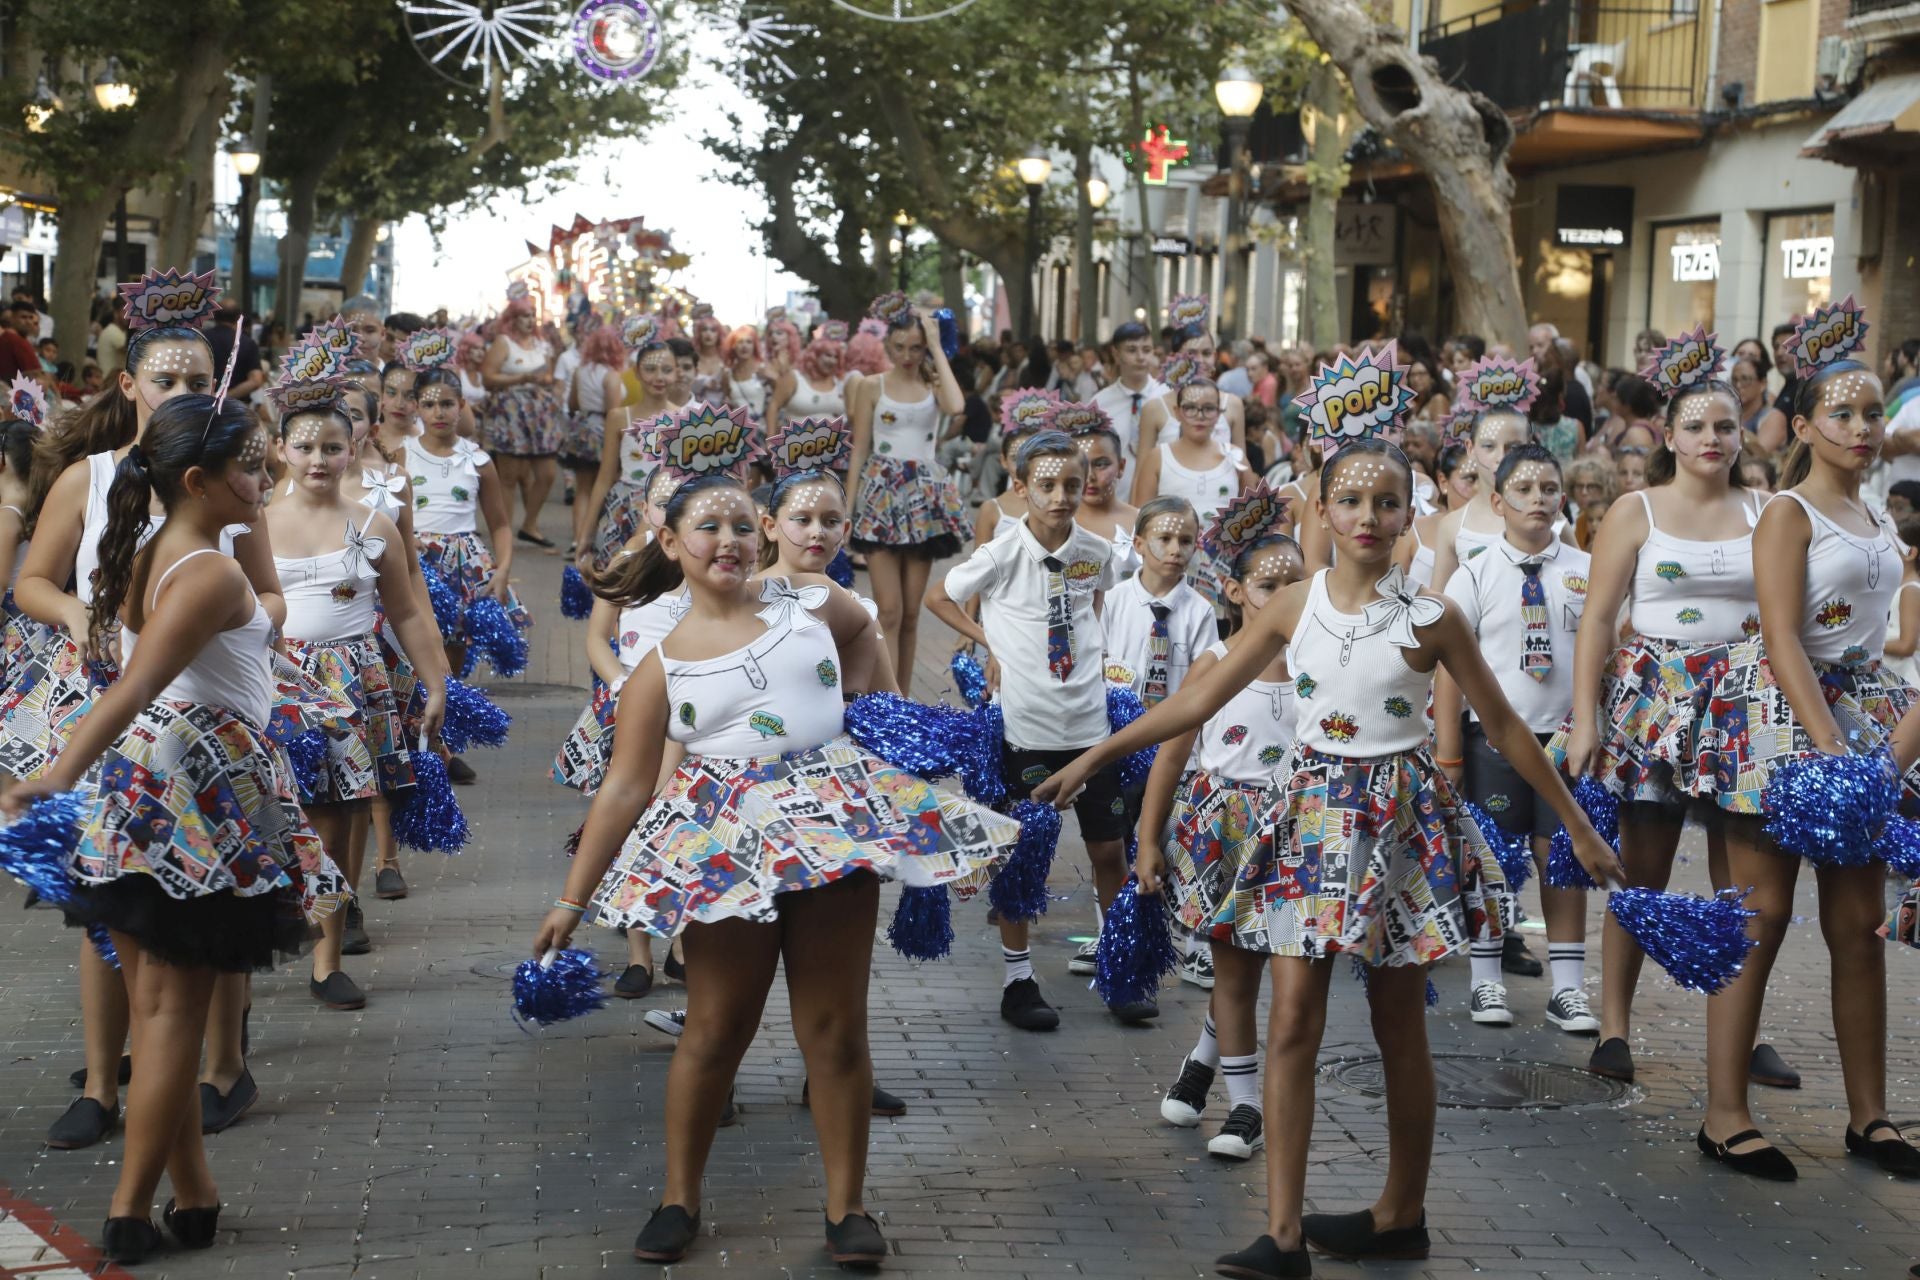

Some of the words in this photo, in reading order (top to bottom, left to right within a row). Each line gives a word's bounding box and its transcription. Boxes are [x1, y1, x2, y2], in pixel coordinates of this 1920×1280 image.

[1558, 228, 1623, 244] TEZENIS
[145, 287, 204, 317] POP!
[414, 336, 447, 364] POP!
[1805, 313, 1855, 362] POP!
[1664, 341, 1710, 386] POP!
[287, 383, 335, 406] POP!
[1323, 370, 1393, 434] POP!
[1480, 376, 1523, 399] POP!
[681, 423, 742, 466] POP!
[787, 431, 838, 466] POP!
[1227, 497, 1270, 541] POP!
[1065, 562, 1101, 578] BANG!
